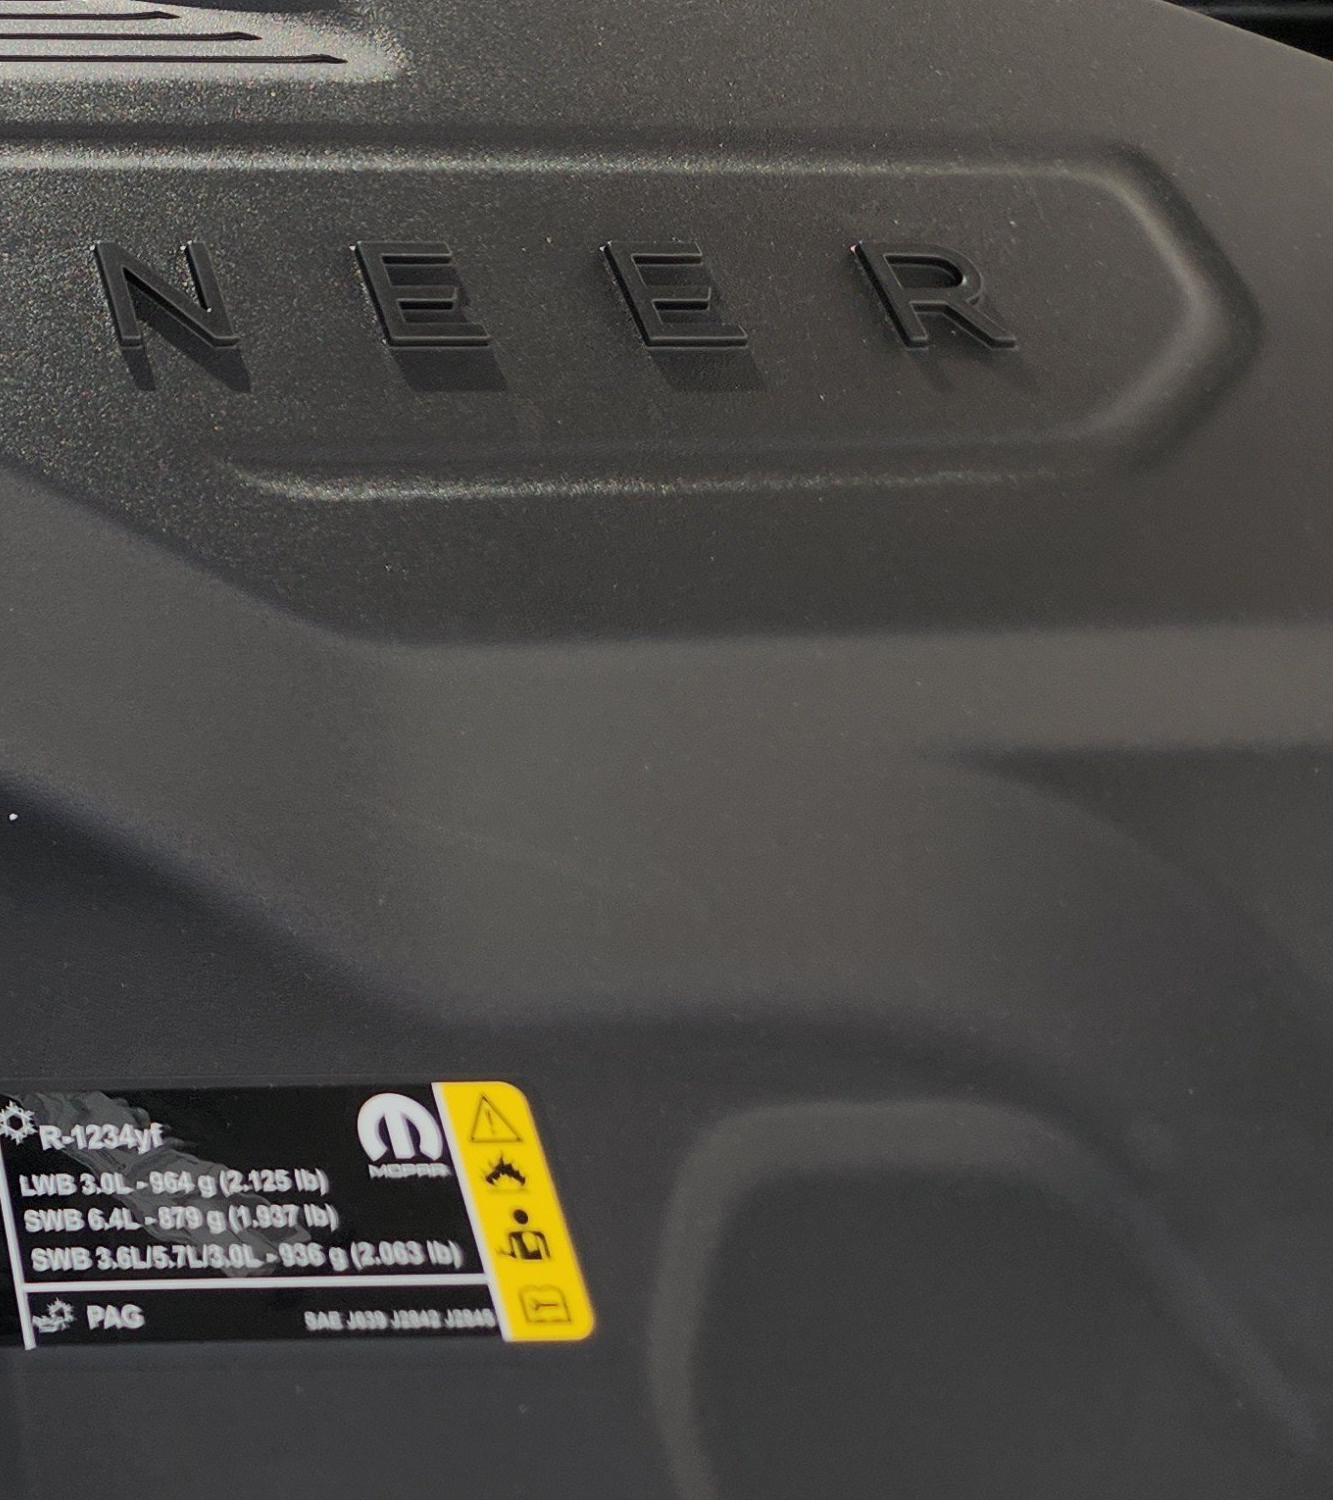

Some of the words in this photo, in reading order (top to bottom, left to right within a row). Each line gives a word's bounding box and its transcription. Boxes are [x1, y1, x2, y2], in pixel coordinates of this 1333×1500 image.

[38, 1121, 164, 1155] R-1234yf
[19, 1173, 77, 1197] LWB
[80, 1172, 134, 1196] 3.0L
[149, 1170, 196, 1195] 964
[197, 1174, 217, 1198] g
[219, 1168, 293, 1197] (2.125
[294, 1167, 330, 1197] lb)
[367, 1162, 453, 1179] MOPAR
[23, 1208, 85, 1233] SWB
[87, 1207, 142, 1231] 6.4L
[157, 1205, 203, 1230] 879
[206, 1210, 226, 1235] g
[228, 1204, 300, 1234] (1.937
[303, 1202, 340, 1232] lb)
[31, 1247, 93, 1272] SWB
[95, 1243, 264, 1270] 3.6L/5.7L/3.0L
[278, 1242, 328, 1267] 936
[328, 1246, 349, 1272] g
[350, 1239, 426, 1271] (2.063
[426, 1239, 464, 1270] lb)
[86, 1303, 146, 1330] PAG
